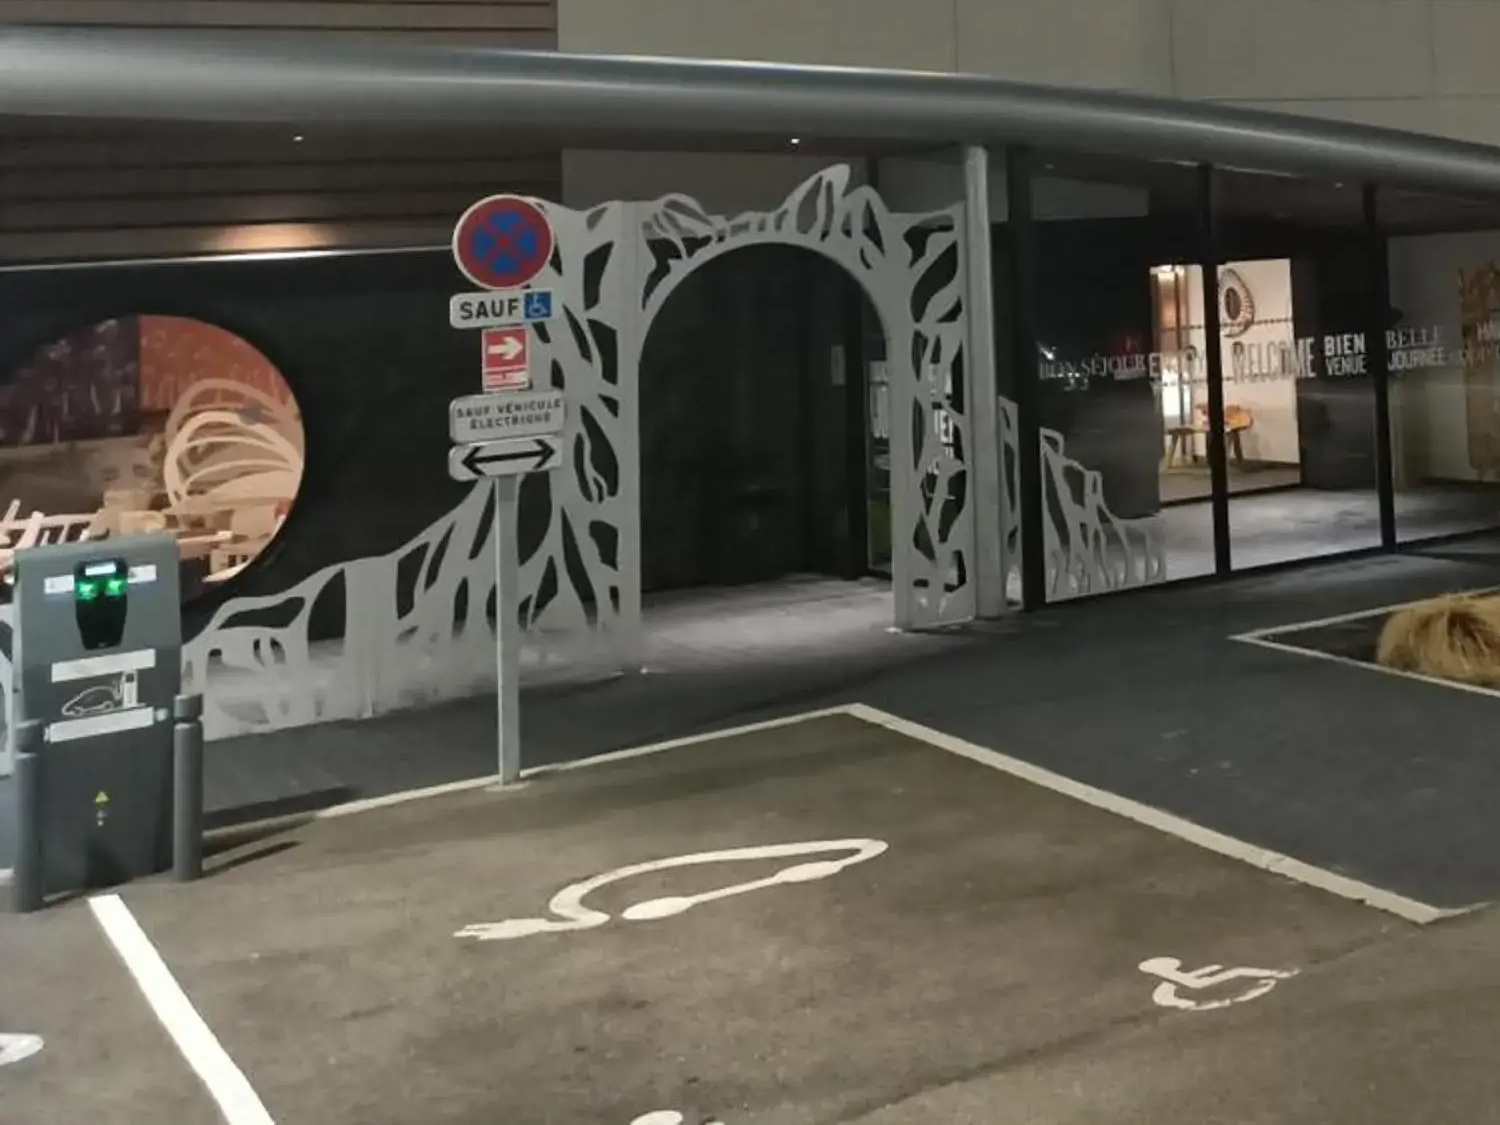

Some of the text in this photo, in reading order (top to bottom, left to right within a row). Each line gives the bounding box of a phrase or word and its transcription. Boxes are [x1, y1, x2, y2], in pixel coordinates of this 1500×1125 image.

[459, 298, 520, 320] SAUF
[1323, 332, 1366, 356] BIEN
[1325, 355, 1368, 377] VENUE
[456, 406, 491, 418] SAUF
